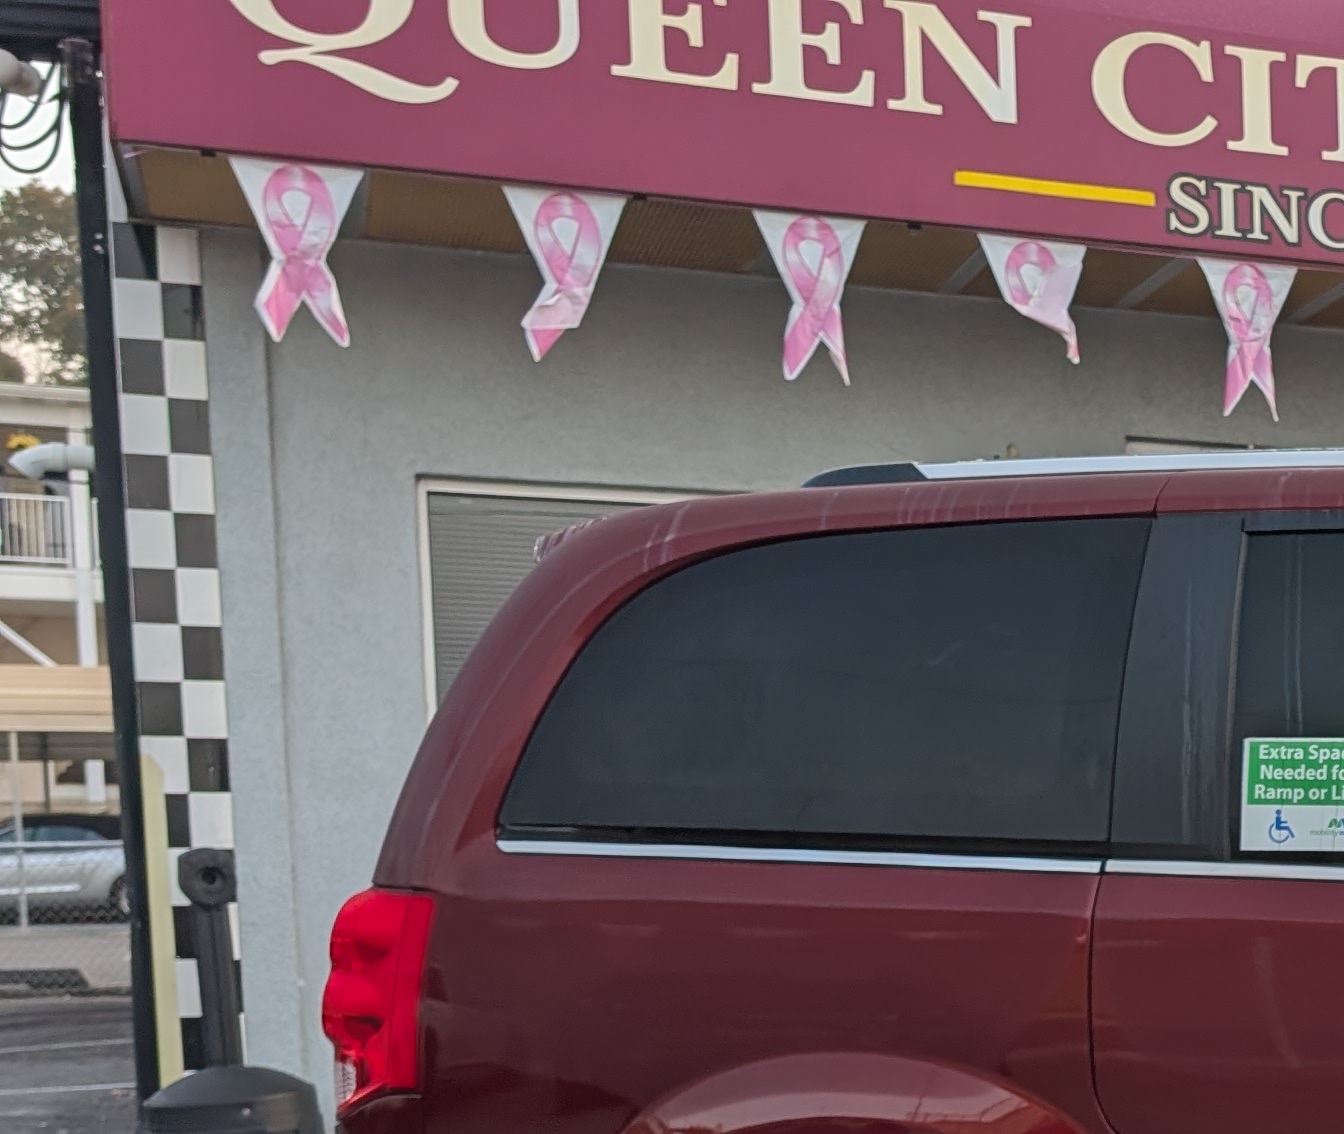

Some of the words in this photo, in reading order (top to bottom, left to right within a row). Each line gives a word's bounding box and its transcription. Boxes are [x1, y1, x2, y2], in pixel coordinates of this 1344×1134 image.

[1258, 744, 1303, 760] Extra
[1260, 764, 1327, 780] Needed
[1254, 784, 1304, 803] Ramp
[1309, 787, 1327, 800] or
